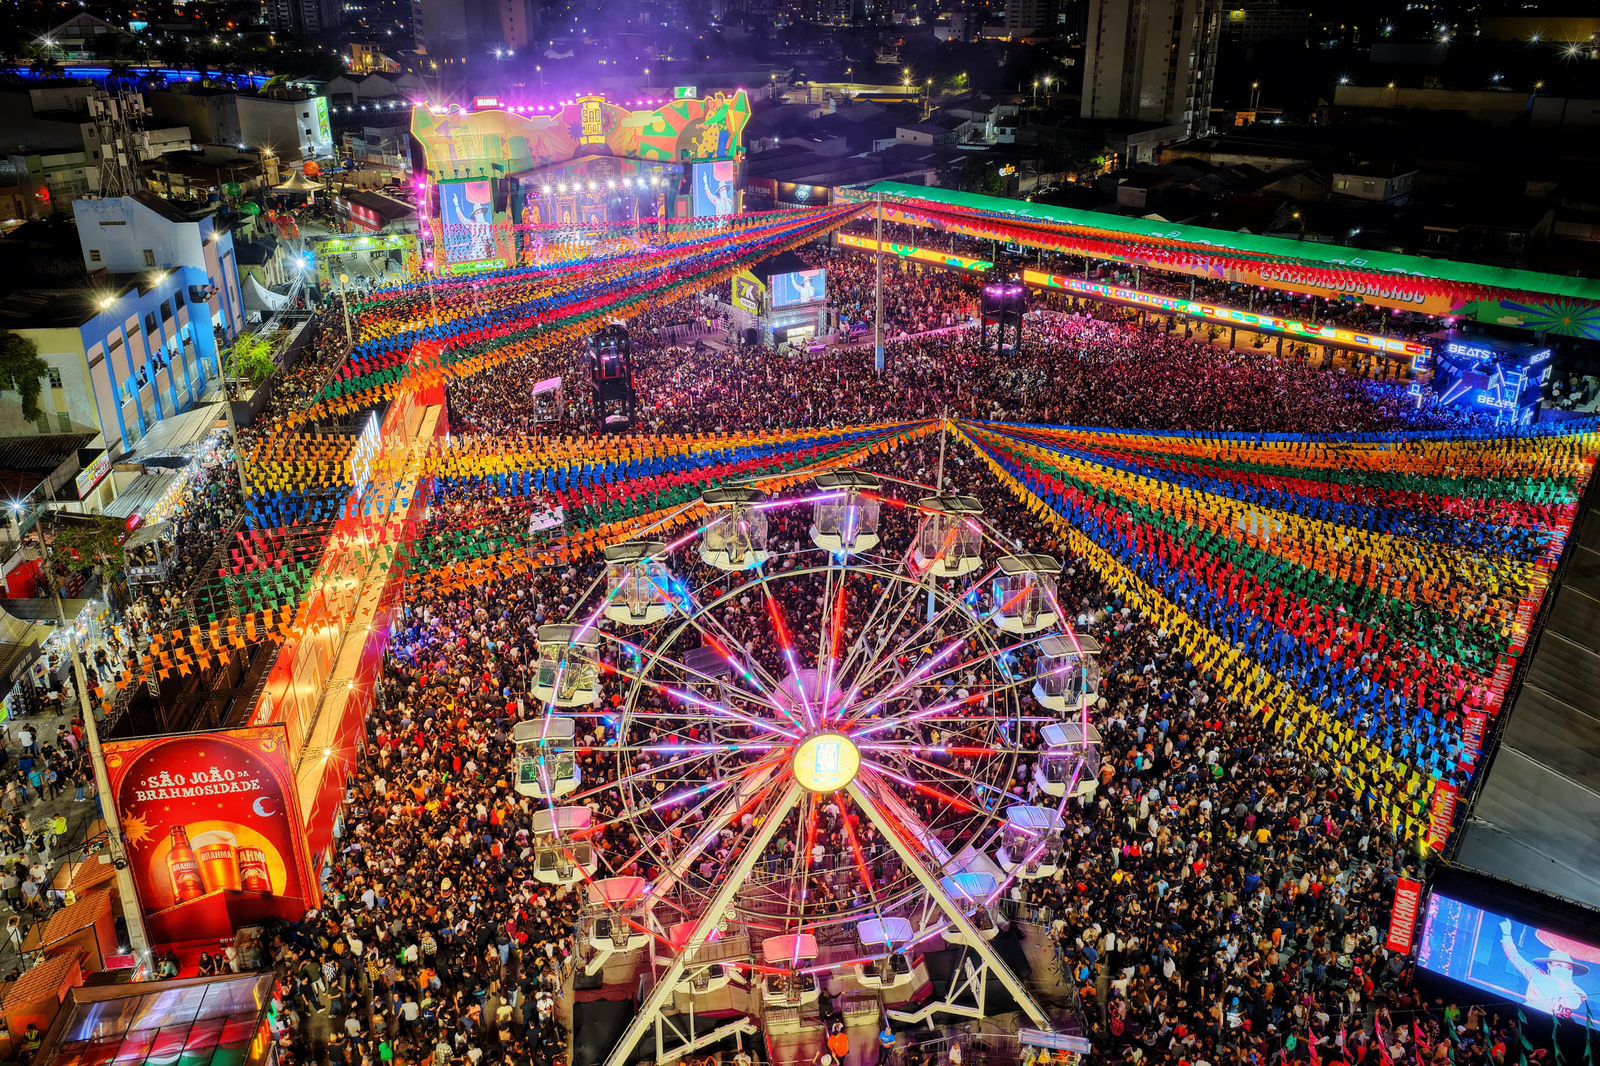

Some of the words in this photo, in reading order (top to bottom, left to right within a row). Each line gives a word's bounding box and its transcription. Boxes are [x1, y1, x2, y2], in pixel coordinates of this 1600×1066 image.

[1449, 343, 1491, 359] BEATS
[1530, 349, 1551, 364] BEATS
[1461, 717, 1483, 763] RAHMA
[148, 771, 185, 788] SÃO
[190, 766, 235, 784] JOÃO
[202, 851, 232, 861] BRAHMA
[1390, 888, 1418, 947] BRAHMA
